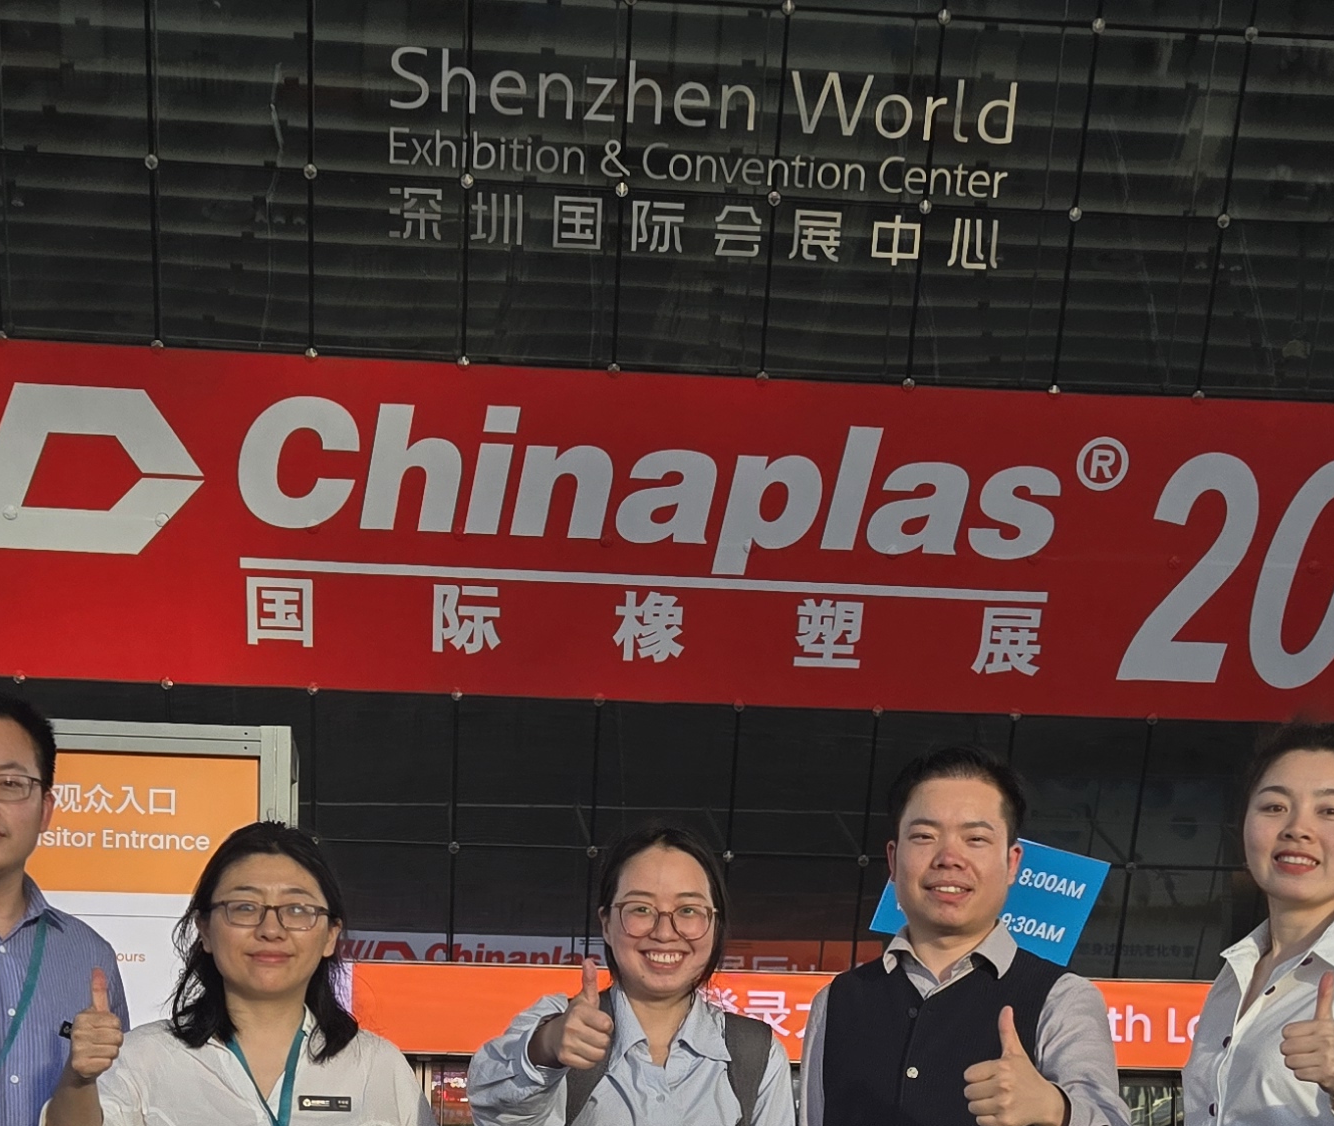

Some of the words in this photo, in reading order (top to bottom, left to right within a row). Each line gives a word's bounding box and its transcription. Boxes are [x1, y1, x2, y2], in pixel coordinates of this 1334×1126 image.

[389, 45, 756, 131] Shenzhen
[791, 70, 1018, 145] World
[388, 127, 586, 175] Exhibition
[599, 140, 631, 178] &
[641, 142, 867, 191] Convention
[878, 156, 1009, 199] Center
[388, 186, 999, 270] 深圳国际会展中心
[244, 575, 1044, 680] 国际橡塑展
[52, 783, 177, 816] 观众入口
[37, 826, 97, 850] isitor
[101, 829, 211, 852] Entrance
[1018, 867, 1087, 900] 8:00AM
[1001, 912, 1066, 943] 9:30AM
[116, 951, 146, 963] ours
[1107, 1004, 1151, 1042] th
